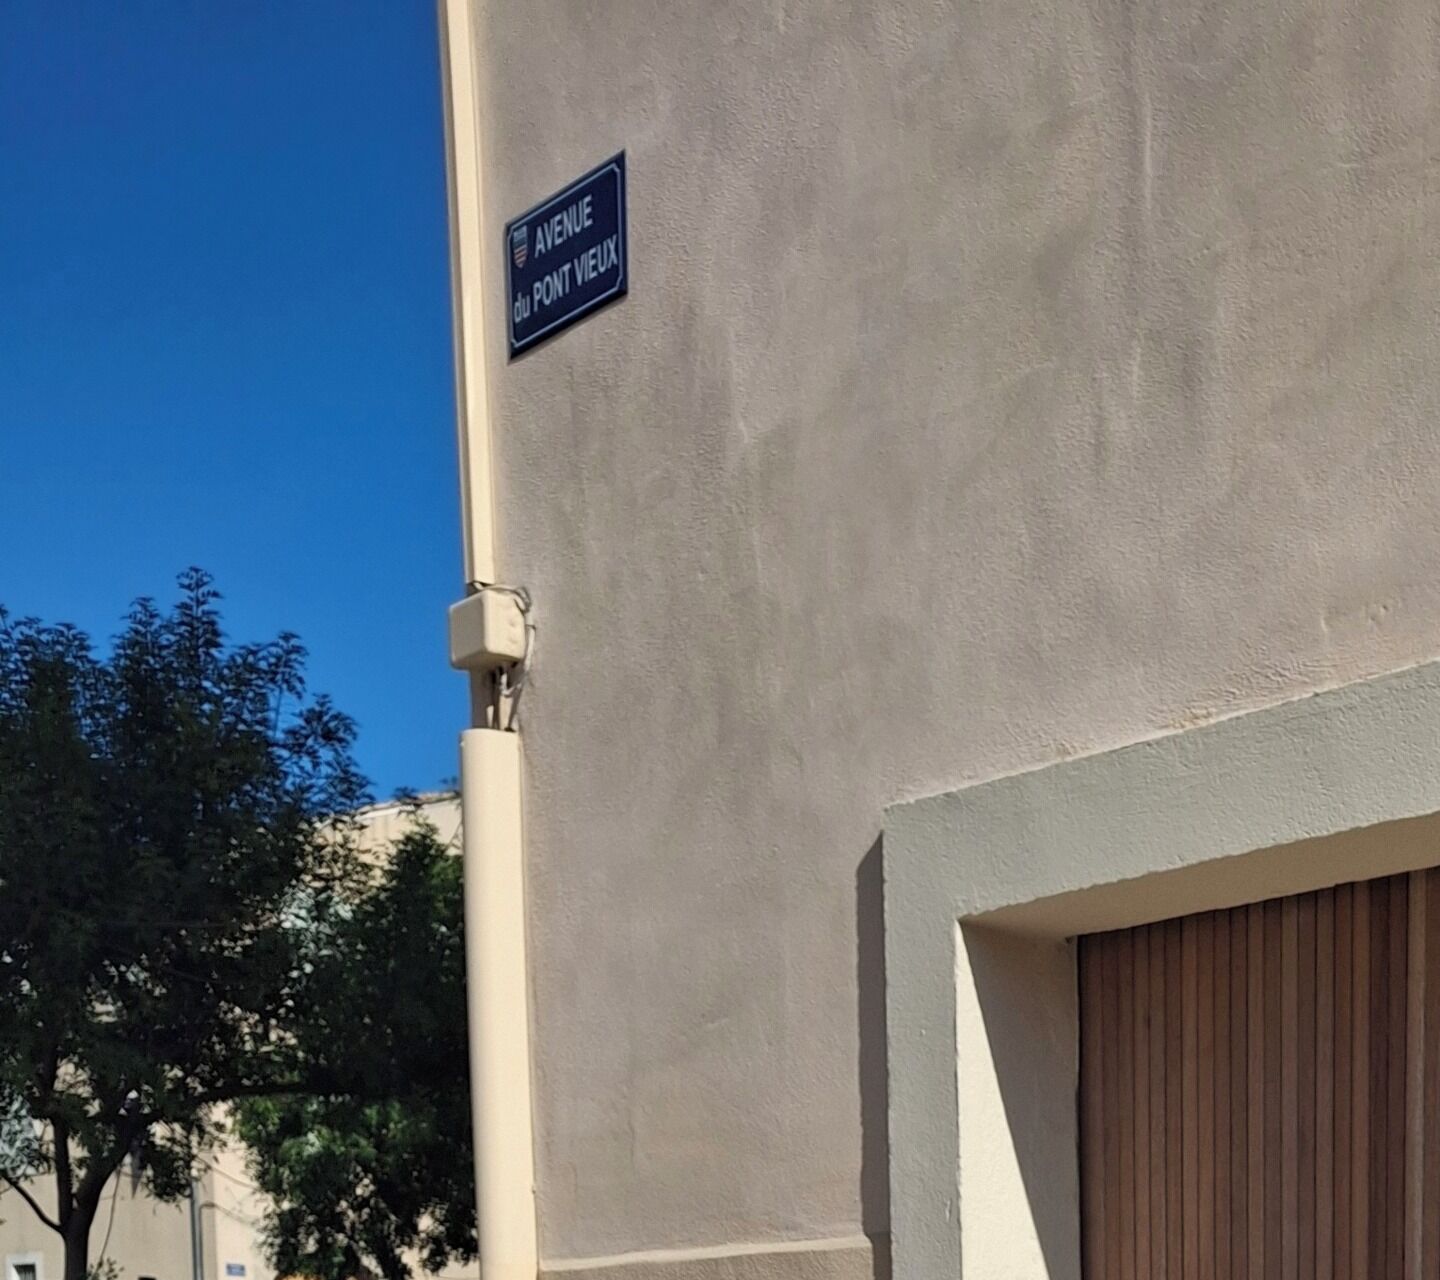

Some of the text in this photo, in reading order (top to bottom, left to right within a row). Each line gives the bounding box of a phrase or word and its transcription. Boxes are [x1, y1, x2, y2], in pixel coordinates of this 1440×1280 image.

[534, 194, 594, 259] AVENUE
[513, 234, 619, 323] du PONT VIEUX
